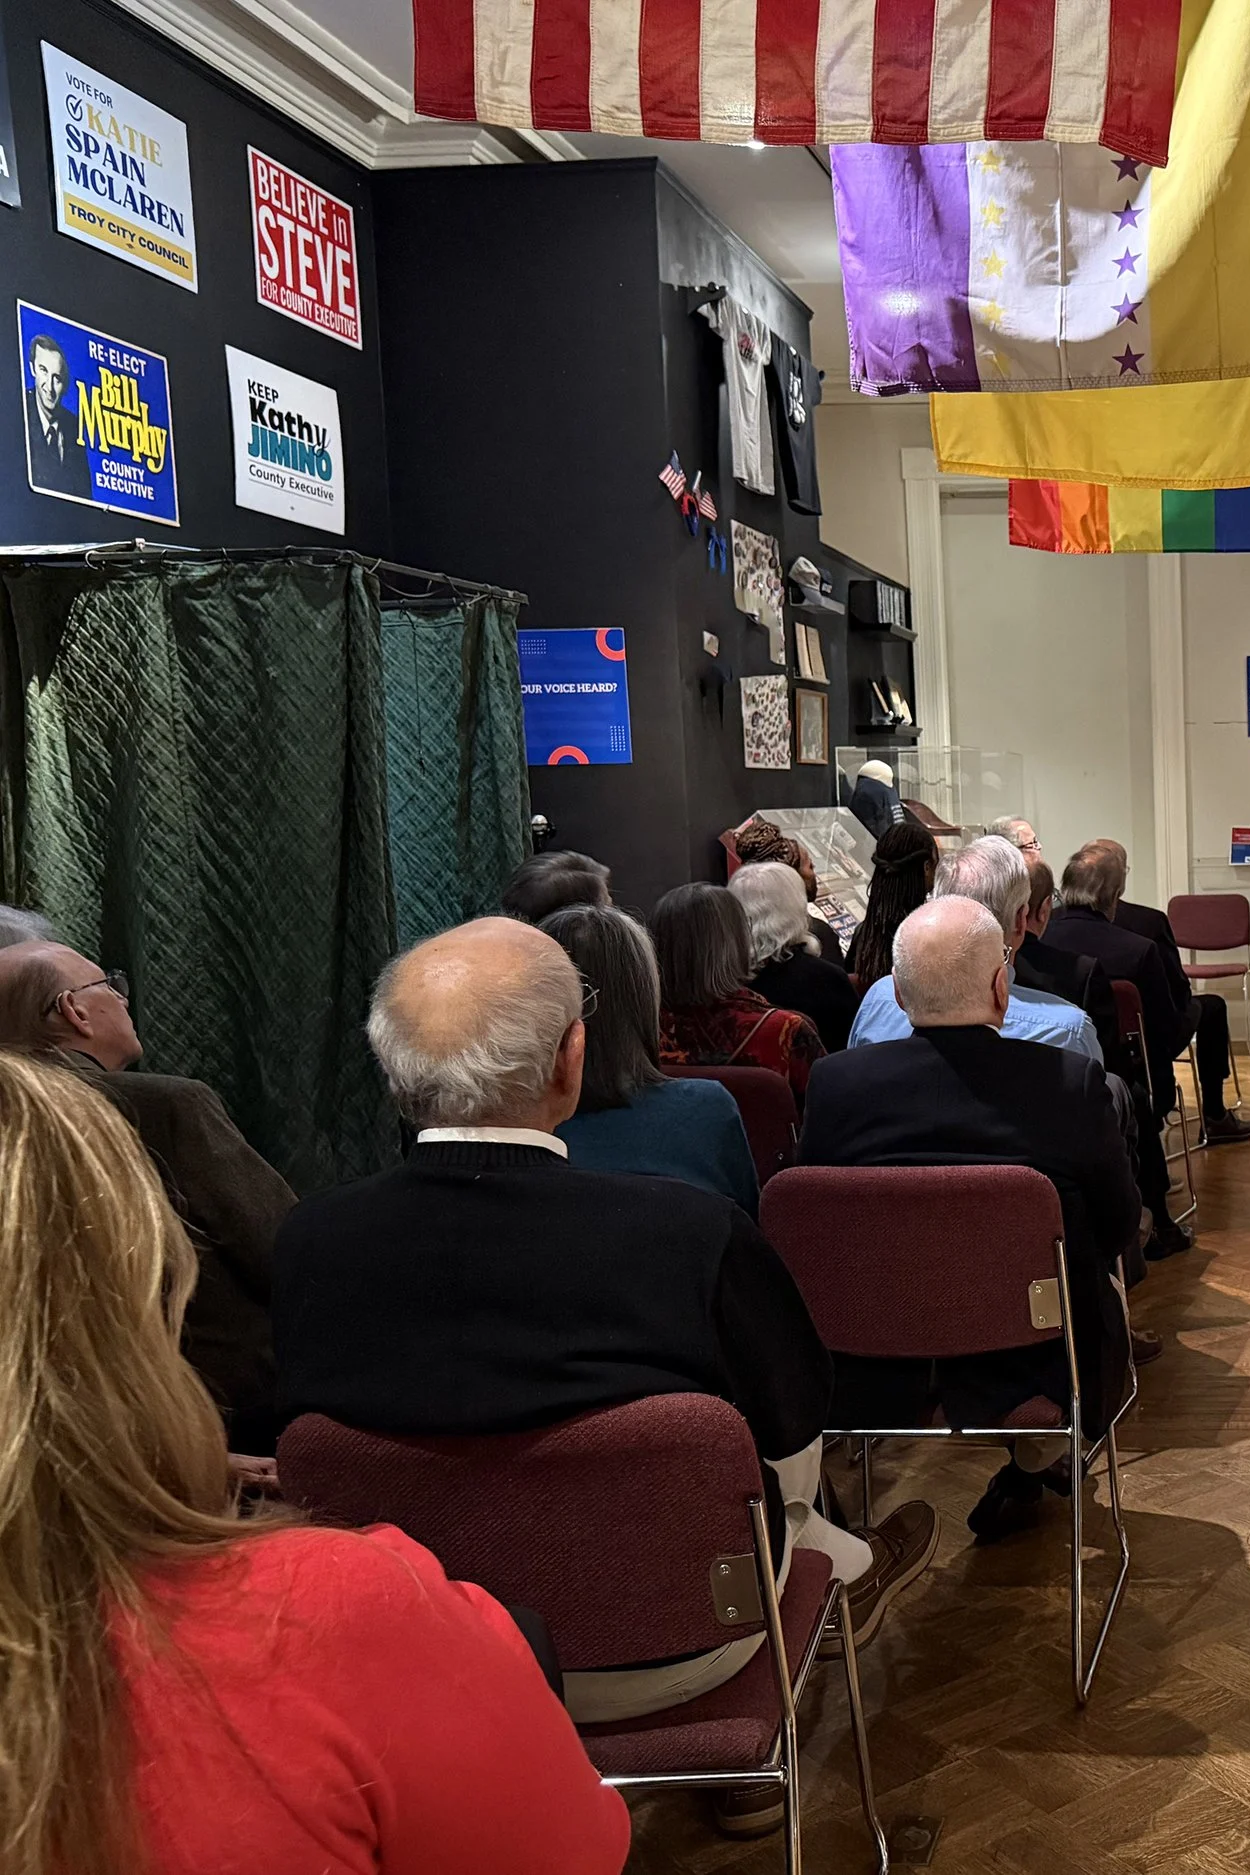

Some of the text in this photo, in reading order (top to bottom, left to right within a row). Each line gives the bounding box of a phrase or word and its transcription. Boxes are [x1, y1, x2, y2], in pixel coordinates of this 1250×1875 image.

[66, 72, 113, 108] VOTE FOR
[66, 123, 146, 187] SPAIN
[86, 103, 163, 167] KATIE
[67, 155, 185, 237] MCLAREN
[256, 159, 348, 246] BELIEVE in
[69, 203, 189, 269] TROY CITY COUNCIL
[258, 204, 355, 317] STEVE
[261, 276, 357, 340] FOR COUNTY EXECUTIVE
[88, 340, 146, 377] RE-ELECT
[99, 366, 140, 416] Bill
[248, 379, 279, 403] KEEP
[76, 380, 167, 473] Murphy
[248, 423, 333, 481] JIMINO
[95, 473, 154, 500] EXECUTIVE
[102, 458, 145, 483] COUNTY
[249, 464, 334, 501] County Executive
[544, 684, 576, 694] VOICE
[577, 683, 618, 693] HEARD?
